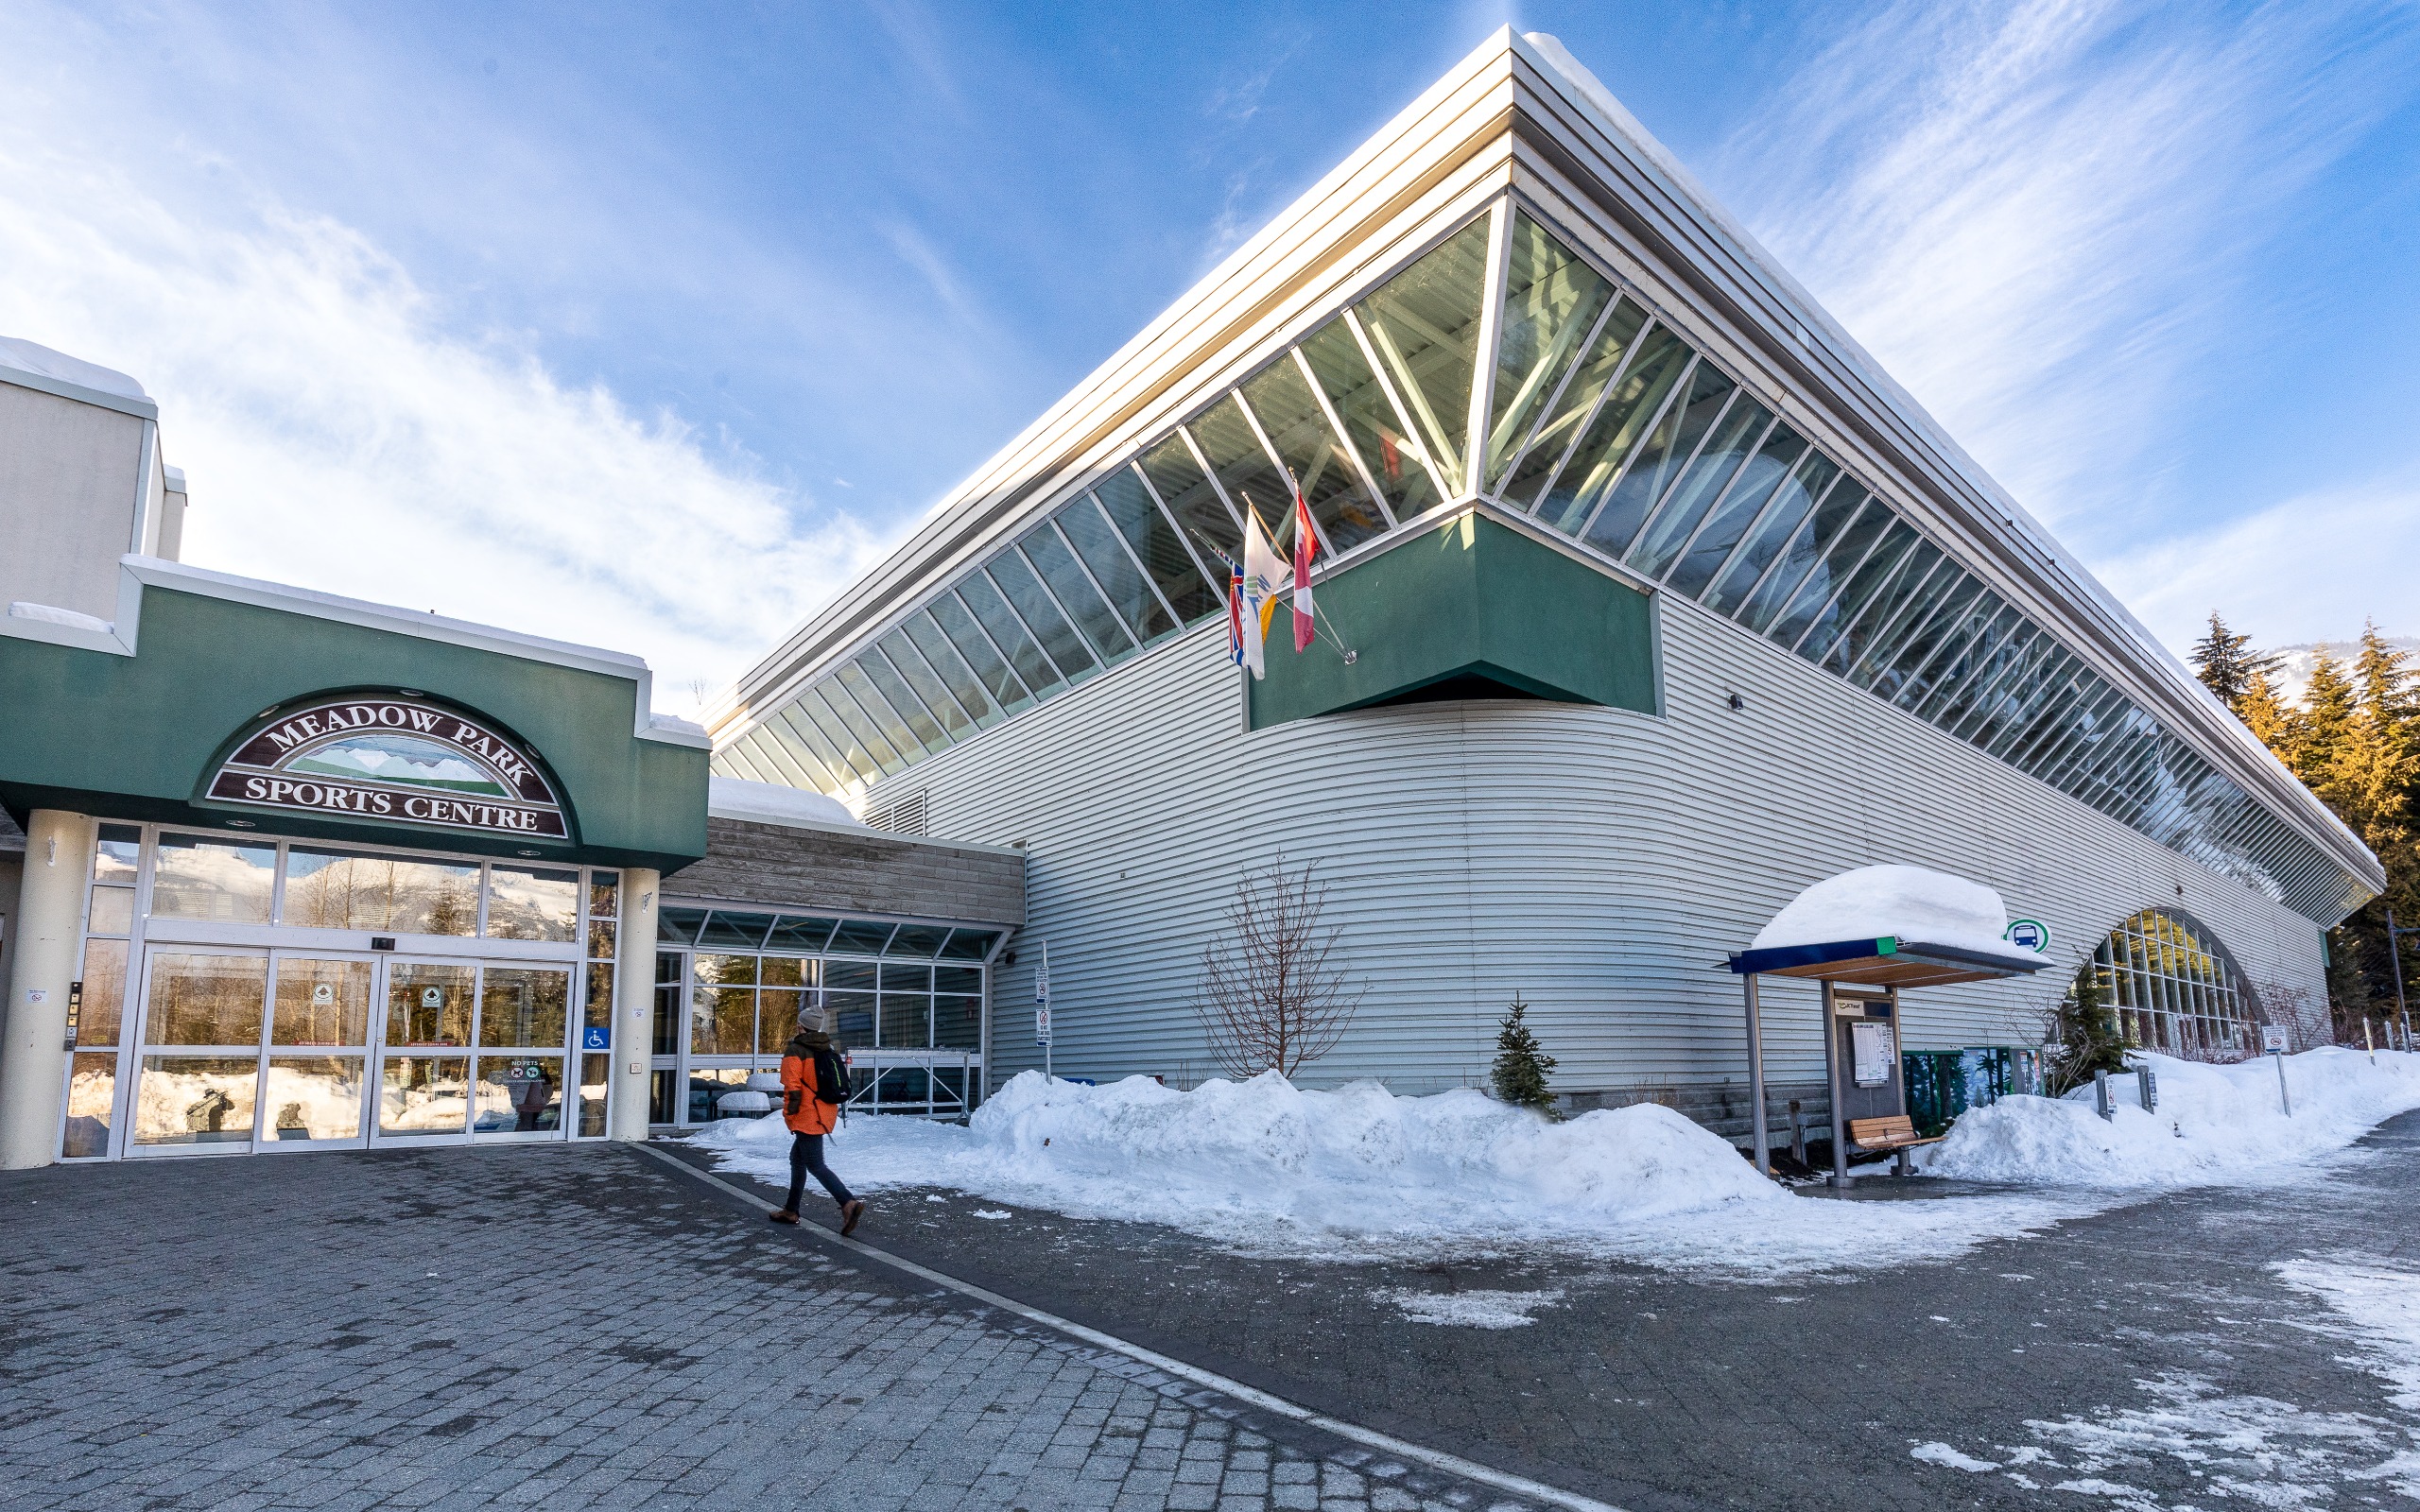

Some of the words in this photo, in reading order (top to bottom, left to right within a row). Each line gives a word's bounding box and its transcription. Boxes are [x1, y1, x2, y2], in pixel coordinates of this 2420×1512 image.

[265, 705, 444, 753] MEADOW
[450, 722, 534, 787] PARK
[244, 778, 391, 814] SPORTS
[404, 798, 538, 831] CENTRE
